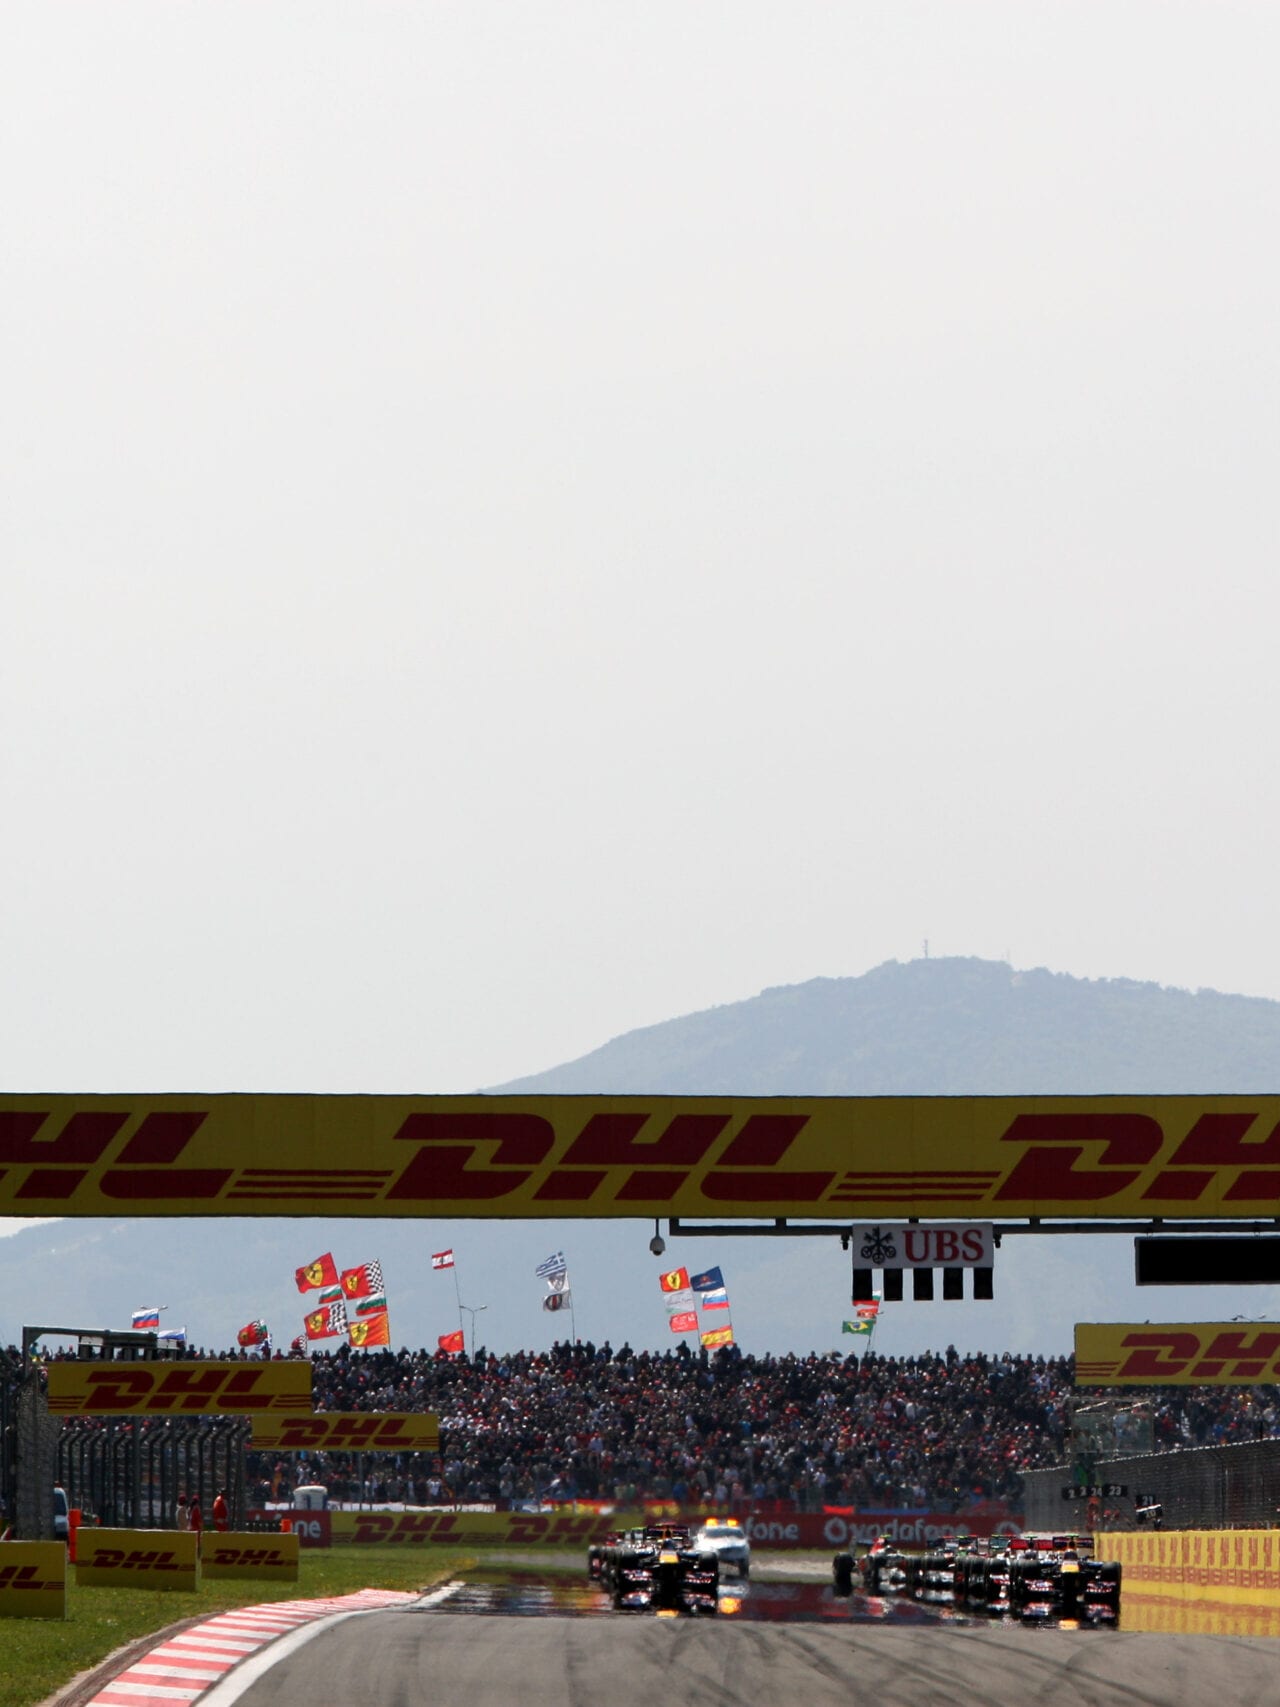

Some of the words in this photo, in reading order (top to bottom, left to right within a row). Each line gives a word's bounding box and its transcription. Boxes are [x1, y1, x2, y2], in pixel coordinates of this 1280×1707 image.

[0, 1111, 234, 1200] HL
[385, 1112, 837, 1201] DHL
[902, 1229, 985, 1263] UBS
[83, 1369, 274, 1410] DHL
[278, 1418, 415, 1447] DHL
[353, 1516, 464, 1543] DHL
[504, 1516, 617, 1543] DHL
[92, 1548, 180, 1571] DHL
[212, 1549, 285, 1567] DHL
